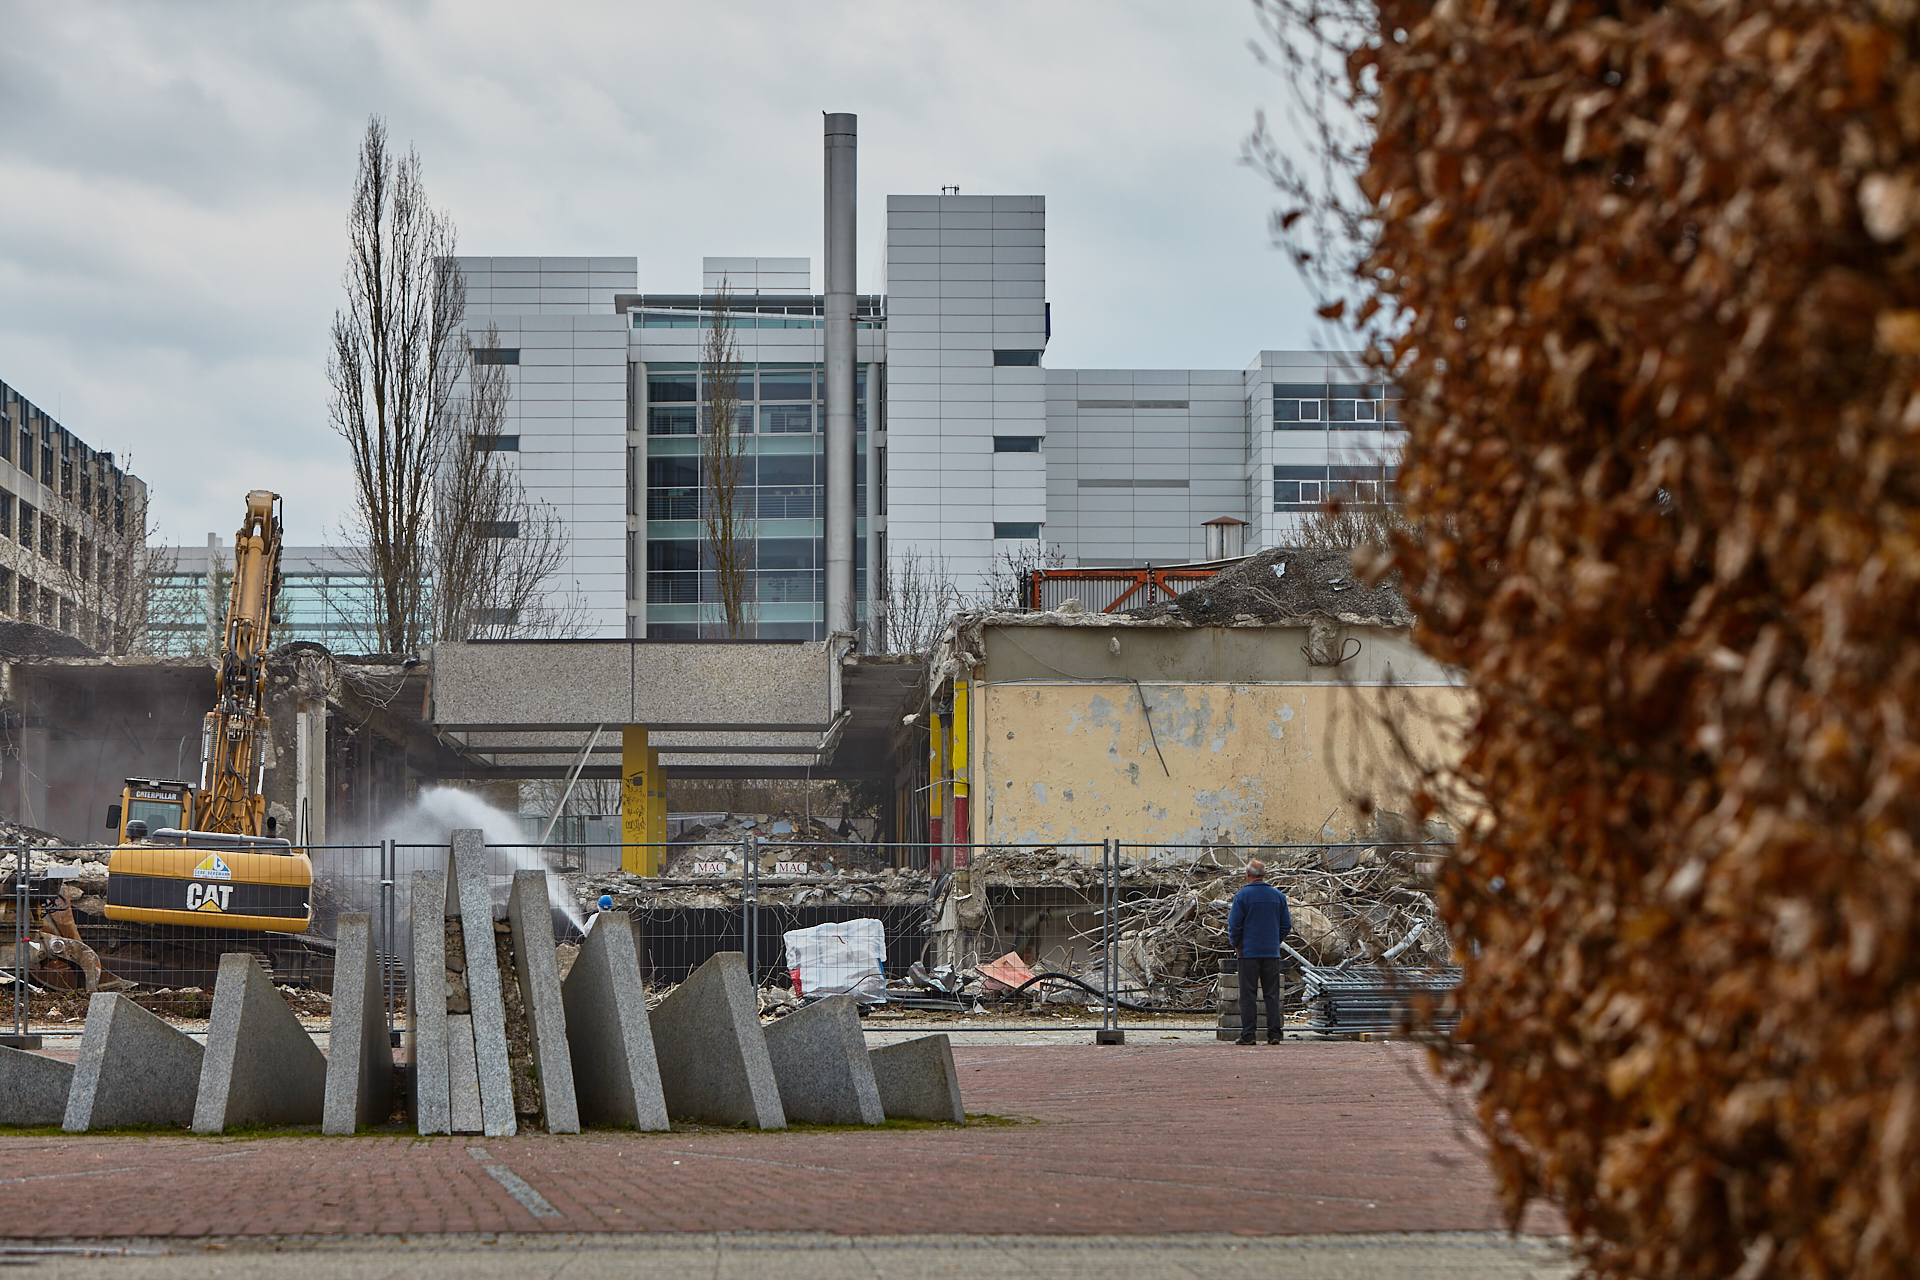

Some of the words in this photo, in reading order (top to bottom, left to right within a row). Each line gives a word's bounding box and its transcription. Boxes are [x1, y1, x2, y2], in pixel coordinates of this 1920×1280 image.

[136, 791, 177, 800] CATERPILLAR
[698, 863, 724, 872] MAC
[779, 863, 805, 872] MAC
[187, 883, 234, 911] CAT
